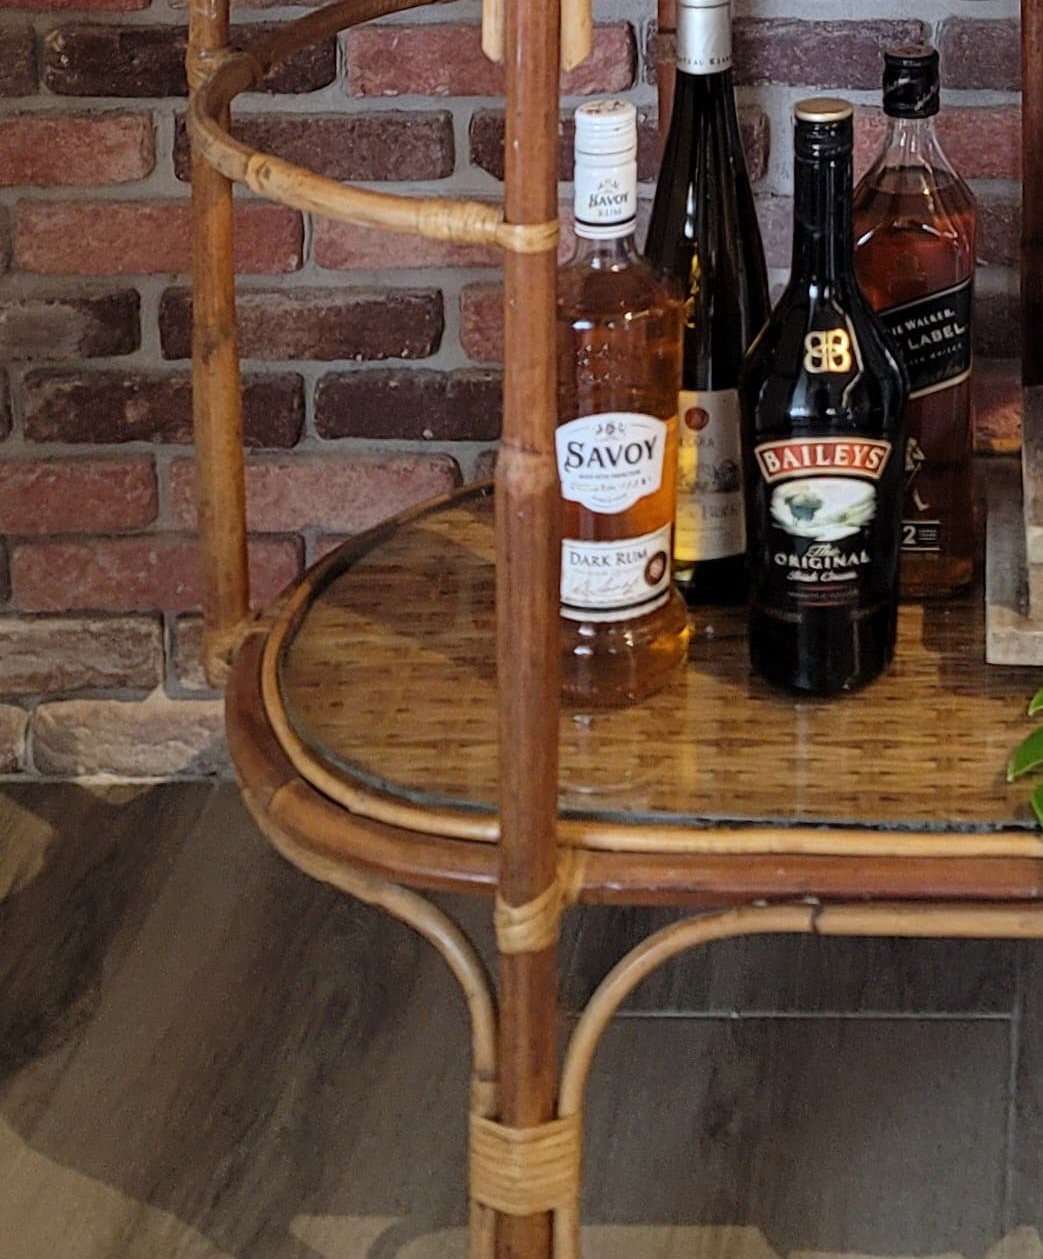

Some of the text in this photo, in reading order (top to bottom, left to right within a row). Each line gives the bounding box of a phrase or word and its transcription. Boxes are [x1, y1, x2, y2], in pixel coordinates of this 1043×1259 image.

[908, 321, 967, 350] LABEL
[564, 436, 657, 473] SAVOY
[763, 443, 886, 475] BAILEYS
[569, 547, 648, 567] DARK RUM
[774, 548, 871, 570] ORIGINAL
